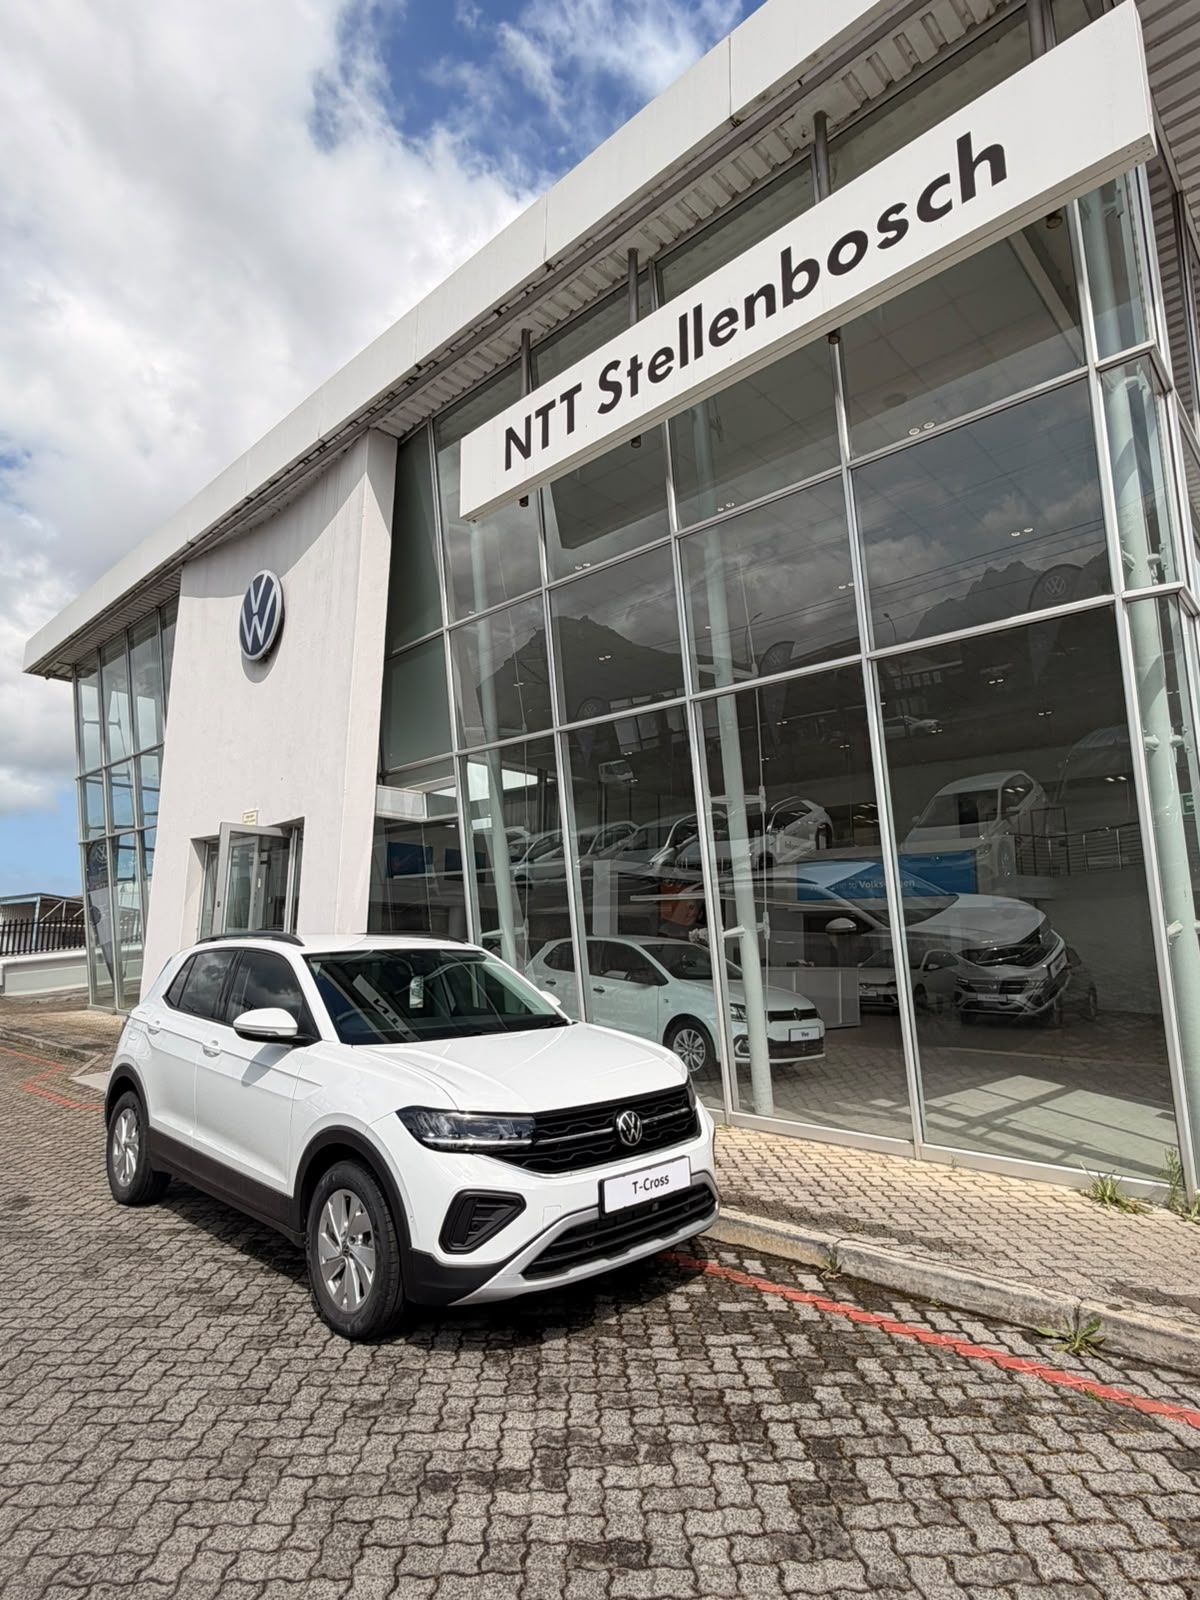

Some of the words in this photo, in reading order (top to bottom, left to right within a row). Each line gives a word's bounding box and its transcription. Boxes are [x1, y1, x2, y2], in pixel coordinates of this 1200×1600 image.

[505, 382, 582, 471] NTT
[597, 131, 1007, 414] Stellenbosch
[632, 1175, 670, 1195] T-Cross
